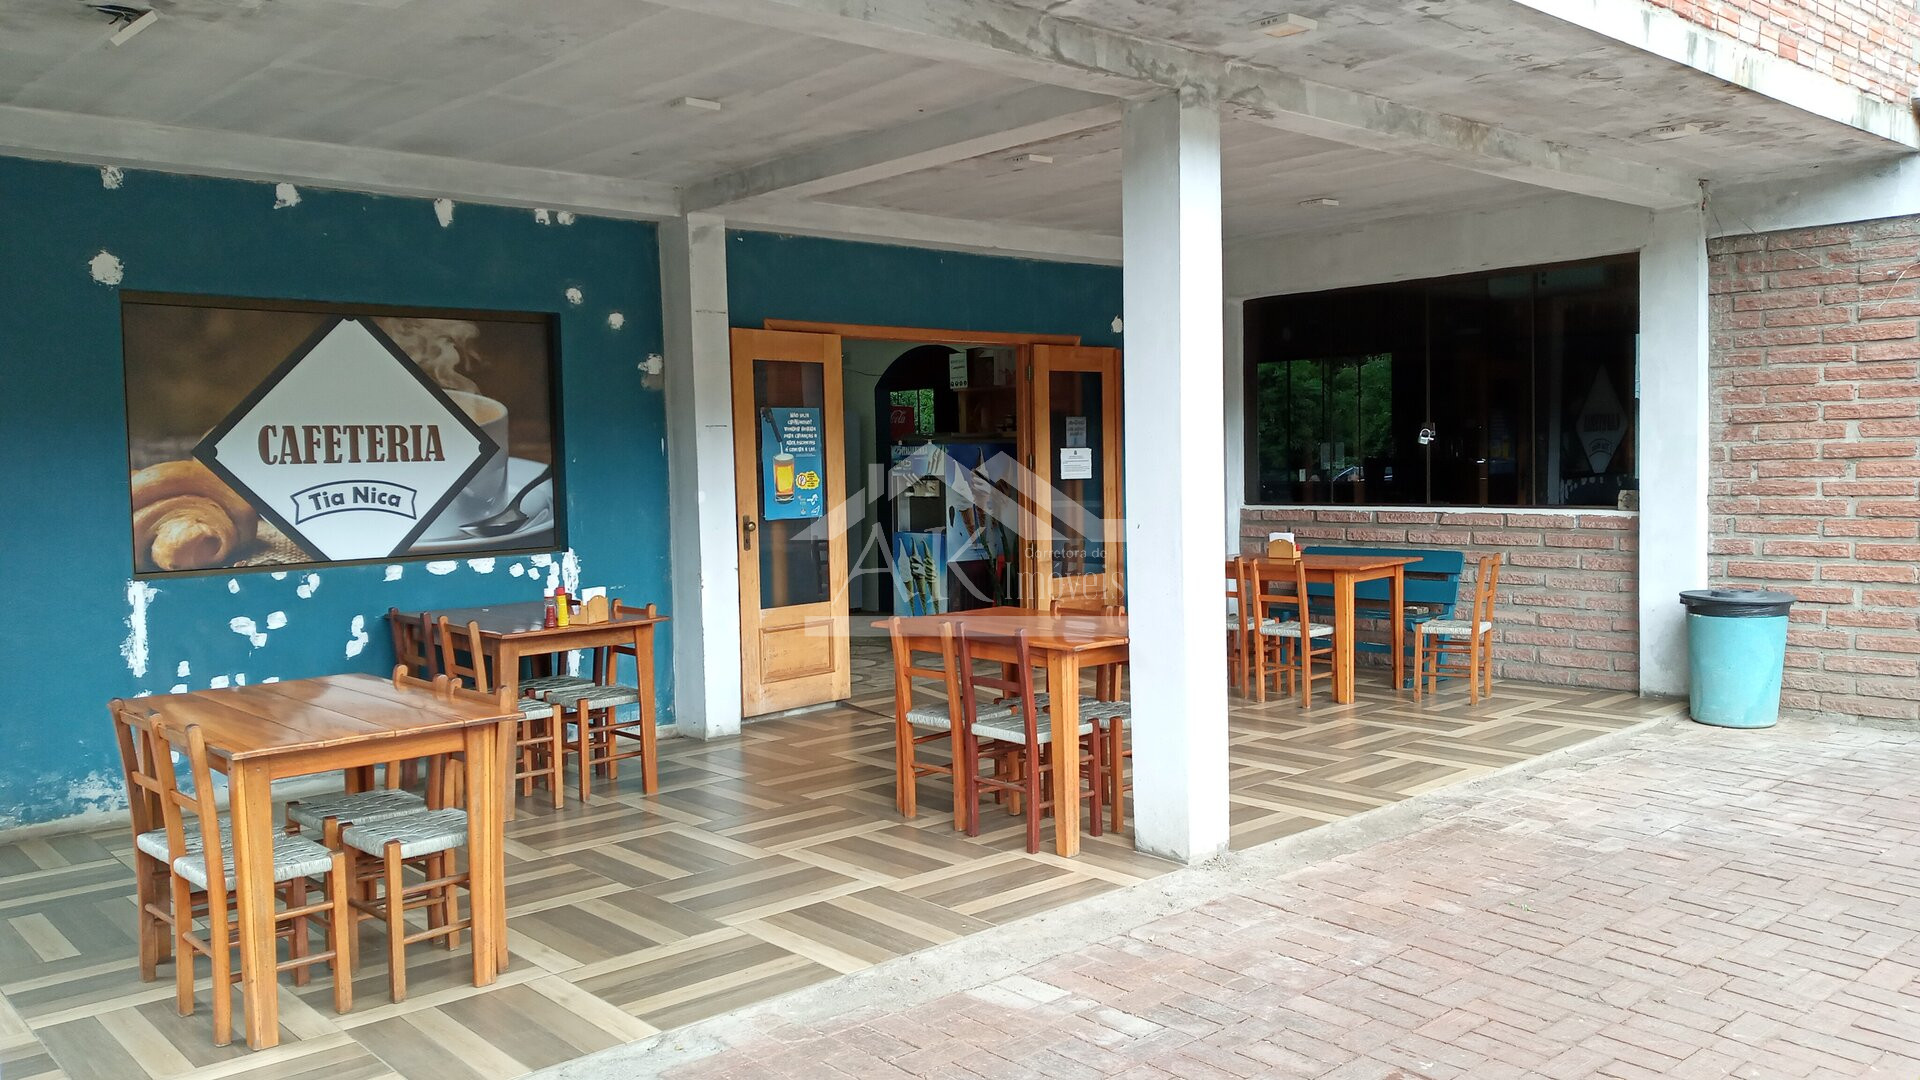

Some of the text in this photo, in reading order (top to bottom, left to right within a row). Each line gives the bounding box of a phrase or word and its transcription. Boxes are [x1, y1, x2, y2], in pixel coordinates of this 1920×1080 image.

[258, 424, 446, 466] CAFETERIA
[309, 486, 402, 511] Tia Nica
